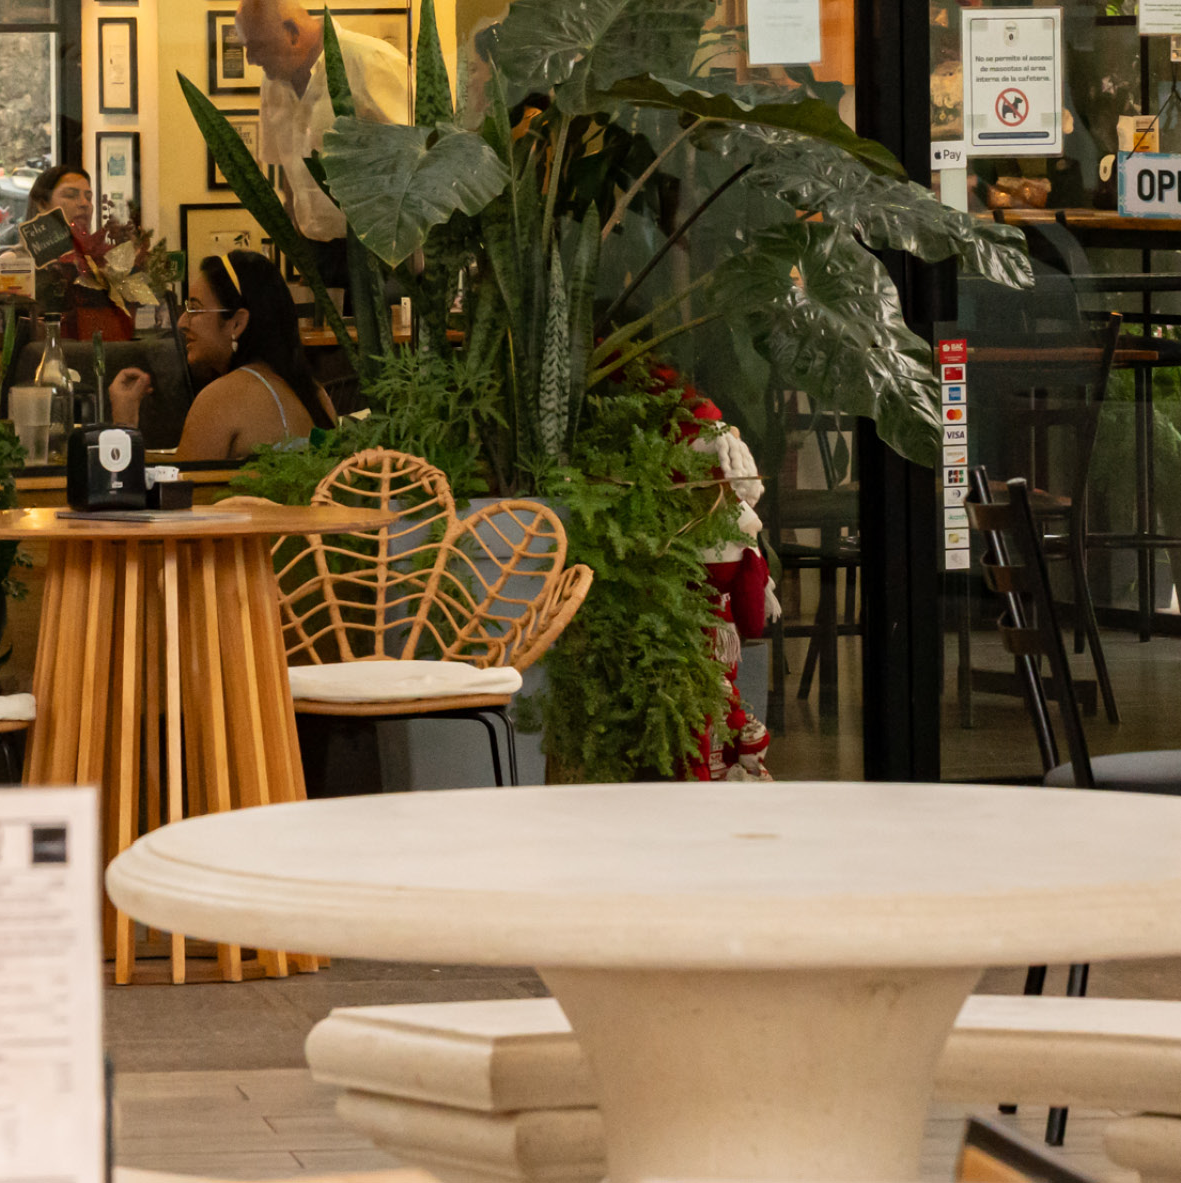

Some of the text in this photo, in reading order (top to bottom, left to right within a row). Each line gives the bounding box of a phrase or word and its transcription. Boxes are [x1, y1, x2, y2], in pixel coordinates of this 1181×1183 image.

[995, 55, 1021, 64] permite
[943, 149, 962, 161] Pay
[1137, 168, 1181, 203] OP
[946, 431, 965, 439] VISA
